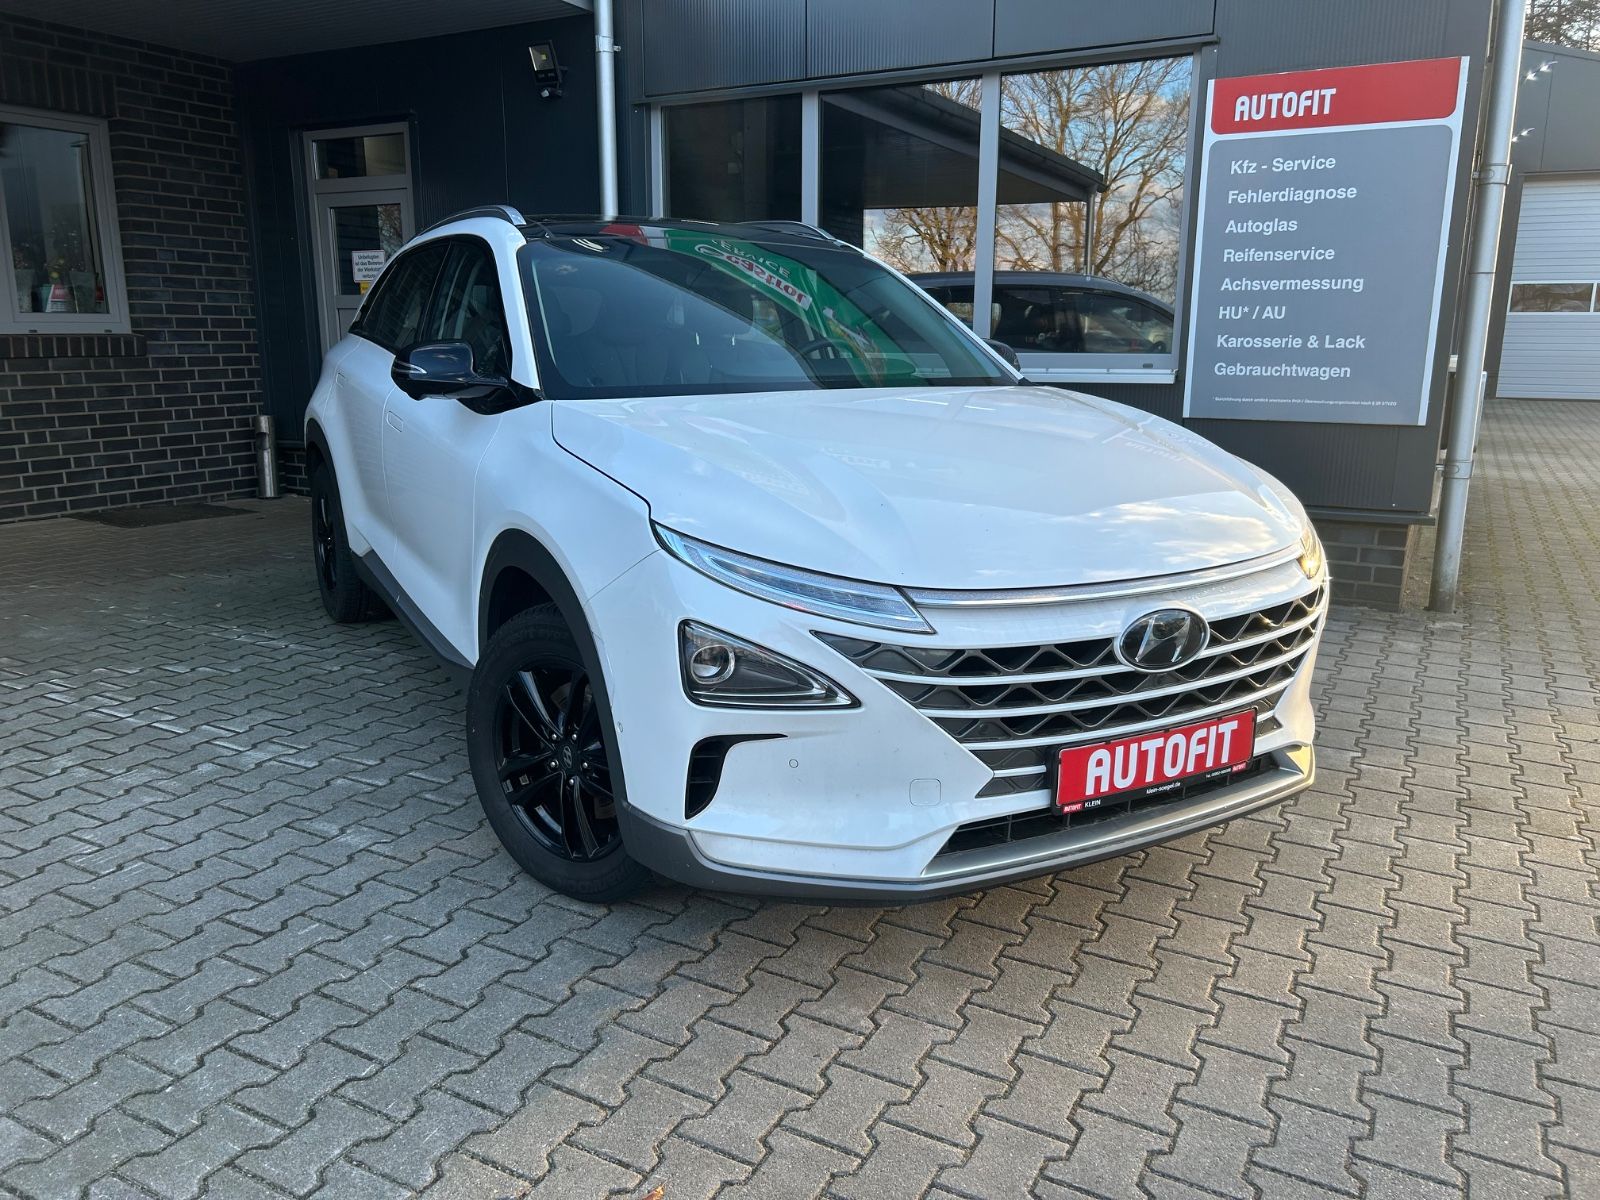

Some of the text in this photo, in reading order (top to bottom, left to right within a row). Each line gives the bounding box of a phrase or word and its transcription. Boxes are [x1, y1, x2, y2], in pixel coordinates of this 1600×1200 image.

[1233, 88, 1337, 122] AUTOFIT
[1230, 159, 1258, 175] Kfz
[1271, 155, 1337, 173] Service
[1227, 185, 1358, 204] Fehlerdiagnose
[1224, 217, 1299, 236] Autoglas
[1222, 246, 1336, 263] Reifenservice
[1220, 277, 1365, 293] Achsvermessung
[1261, 305, 1286, 320] AU
[1216, 334, 1366, 349] Karosserie & Lack
[1214, 362, 1352, 381] Gebrauchtwagen
[1085, 720, 1239, 796] AUTOFIT
[1084, 799, 1101, 808] KLEIN
